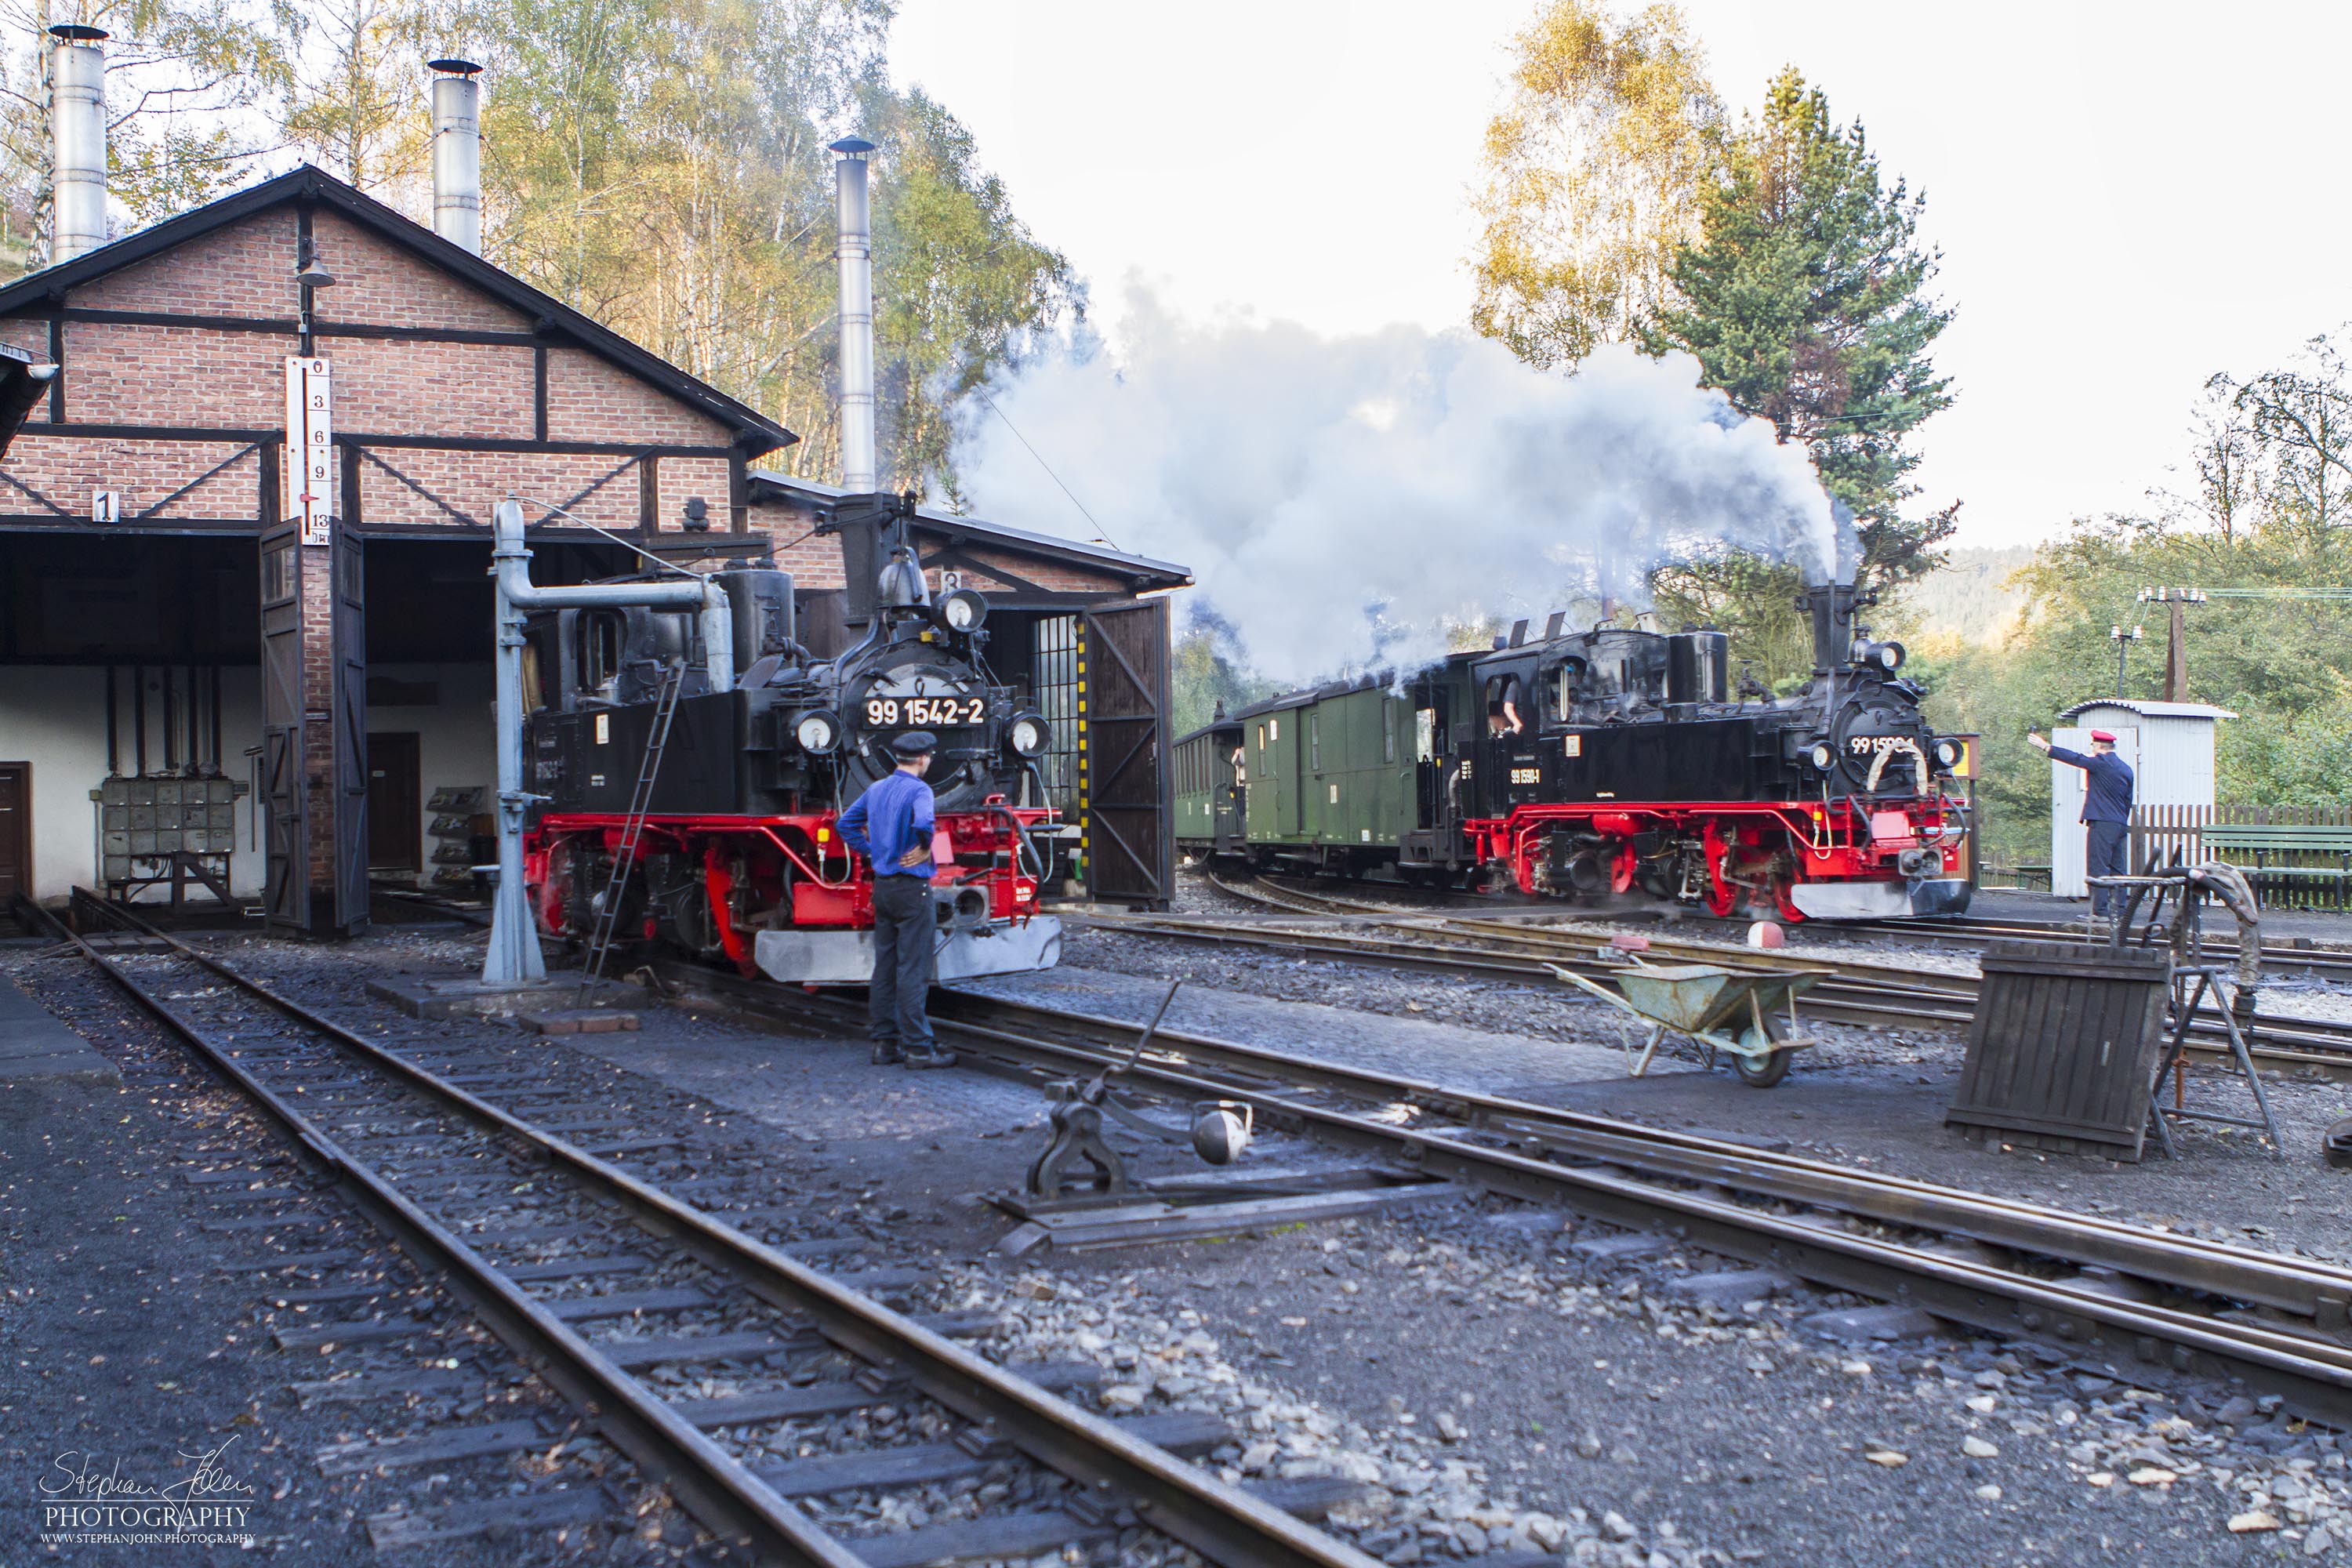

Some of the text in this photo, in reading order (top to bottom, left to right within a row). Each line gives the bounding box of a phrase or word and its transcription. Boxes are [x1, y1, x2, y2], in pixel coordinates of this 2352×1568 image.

[313, 360, 323, 374] 0
[314, 394, 324, 408] 3
[314, 430, 325, 444] 6
[314, 465, 325, 479] 9
[97, 492, 112, 521] 1
[313, 514, 329, 528] 13
[867, 698, 984, 725] 99 1542-2
[1851, 737, 1871, 754] 99
[1511, 768, 1519, 784] 99
